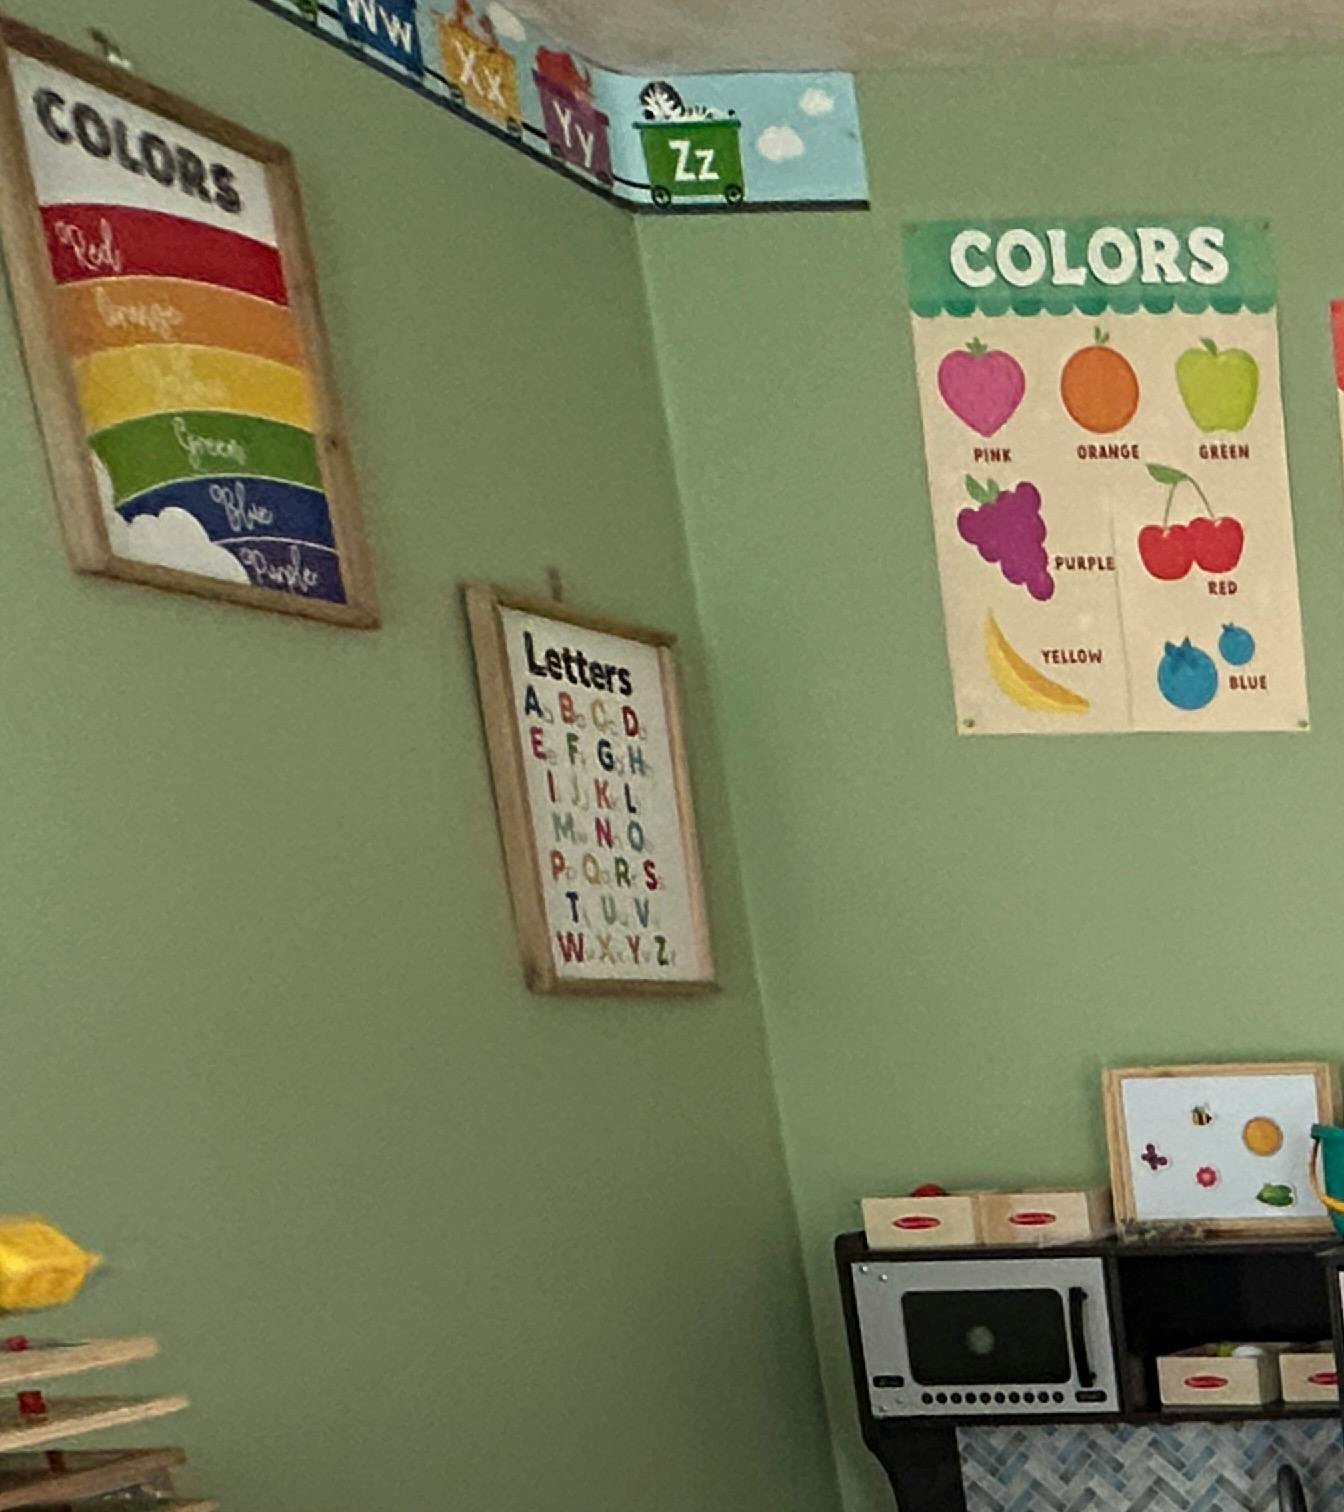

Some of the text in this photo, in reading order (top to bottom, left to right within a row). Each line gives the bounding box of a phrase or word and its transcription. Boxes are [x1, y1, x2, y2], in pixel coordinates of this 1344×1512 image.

[454, 40, 510, 118] Xx
[32, 86, 243, 214] COLORS
[552, 97, 595, 168] Yy
[668, 138, 721, 182] Zz
[54, 217, 123, 274] Red
[949, 226, 1231, 288] COLORS
[973, 443, 1250, 464] PINK ORANGE GREEN
[208, 480, 274, 532] Blue
[238, 544, 318, 592] Purple
[1054, 555, 1116, 571] PURPLE
[1207, 580, 1238, 596] RED
[523, 631, 634, 696] Letters
[1041, 648, 1103, 665] YELLOW
[1228, 674, 1268, 691] BLUE
